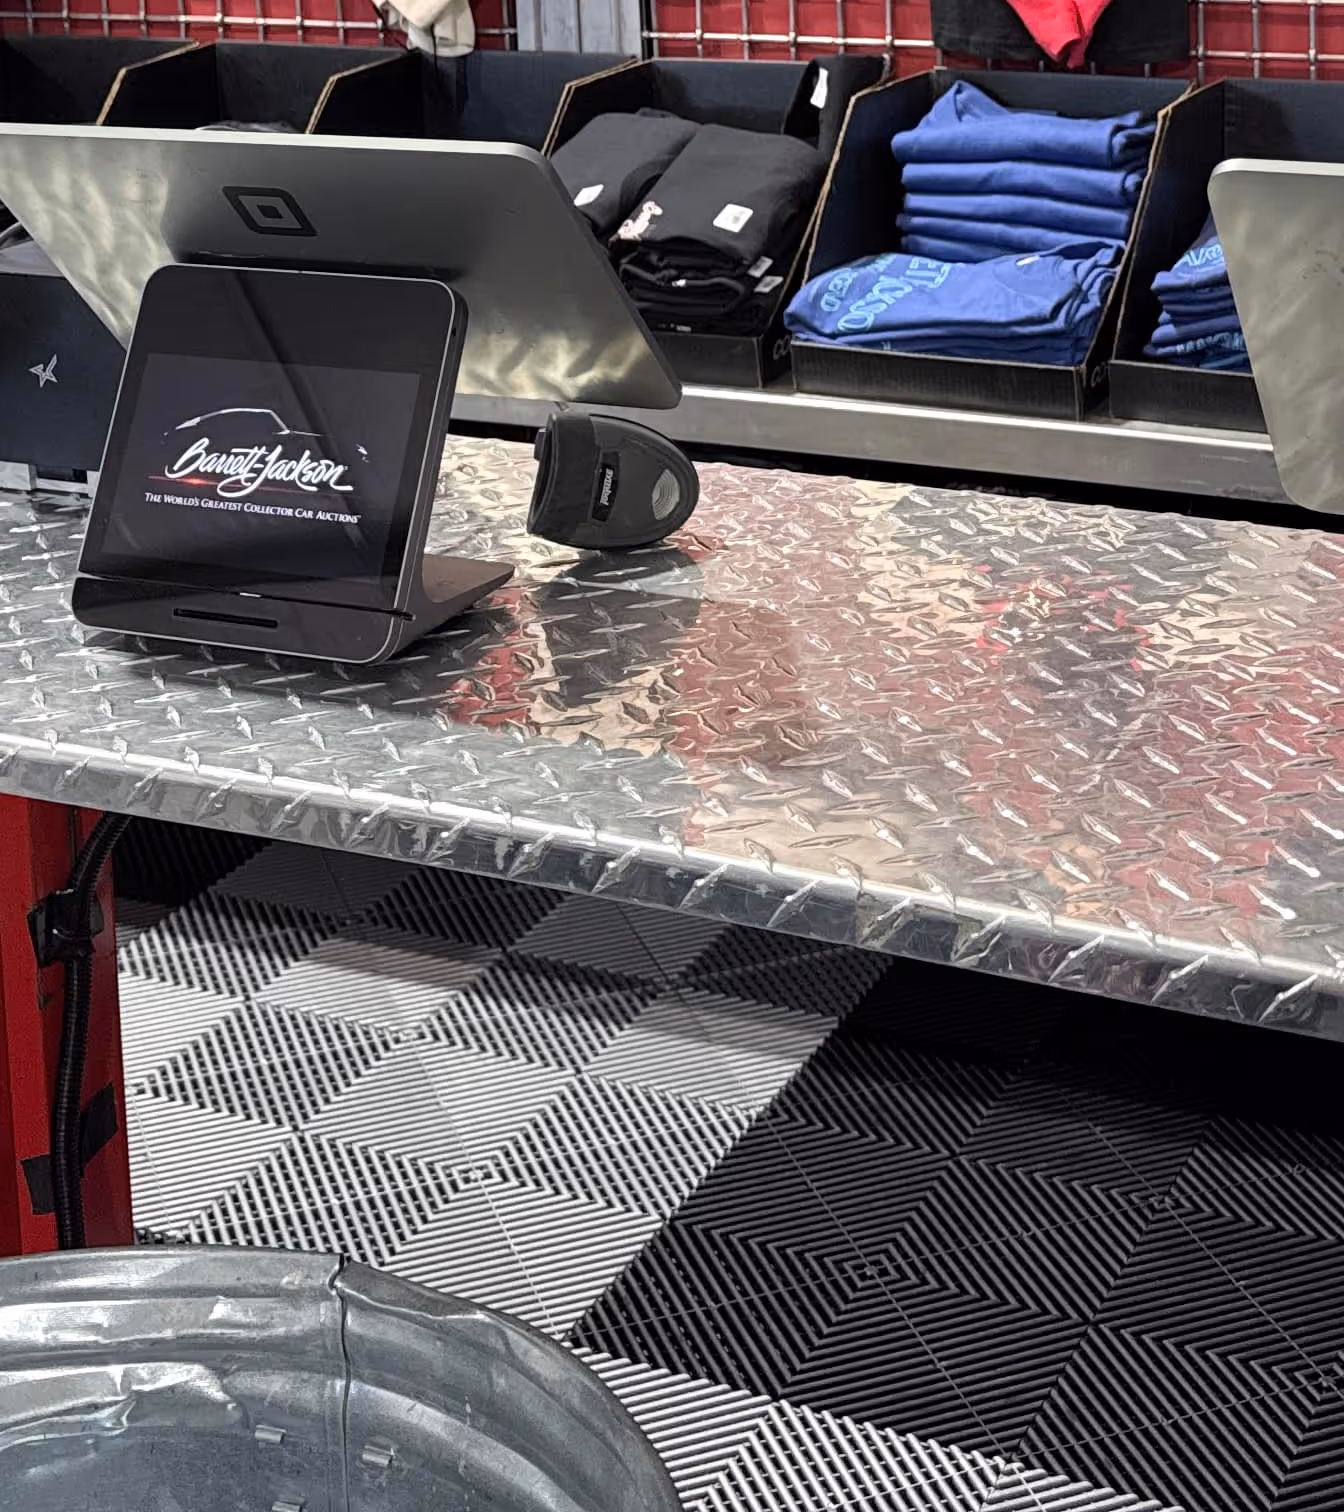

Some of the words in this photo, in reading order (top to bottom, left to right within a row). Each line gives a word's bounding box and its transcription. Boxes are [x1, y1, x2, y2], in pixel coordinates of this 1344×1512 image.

[164, 437, 354, 499] Barrett-Jackson
[144, 492, 162, 505] THE
[163, 494, 200, 508] WORLD'S
[201, 498, 243, 513] GREATEST
[244, 502, 294, 518] COLLECTOR
[294, 507, 314, 521] CAR
[315, 510, 359, 524] AUCTIONS
